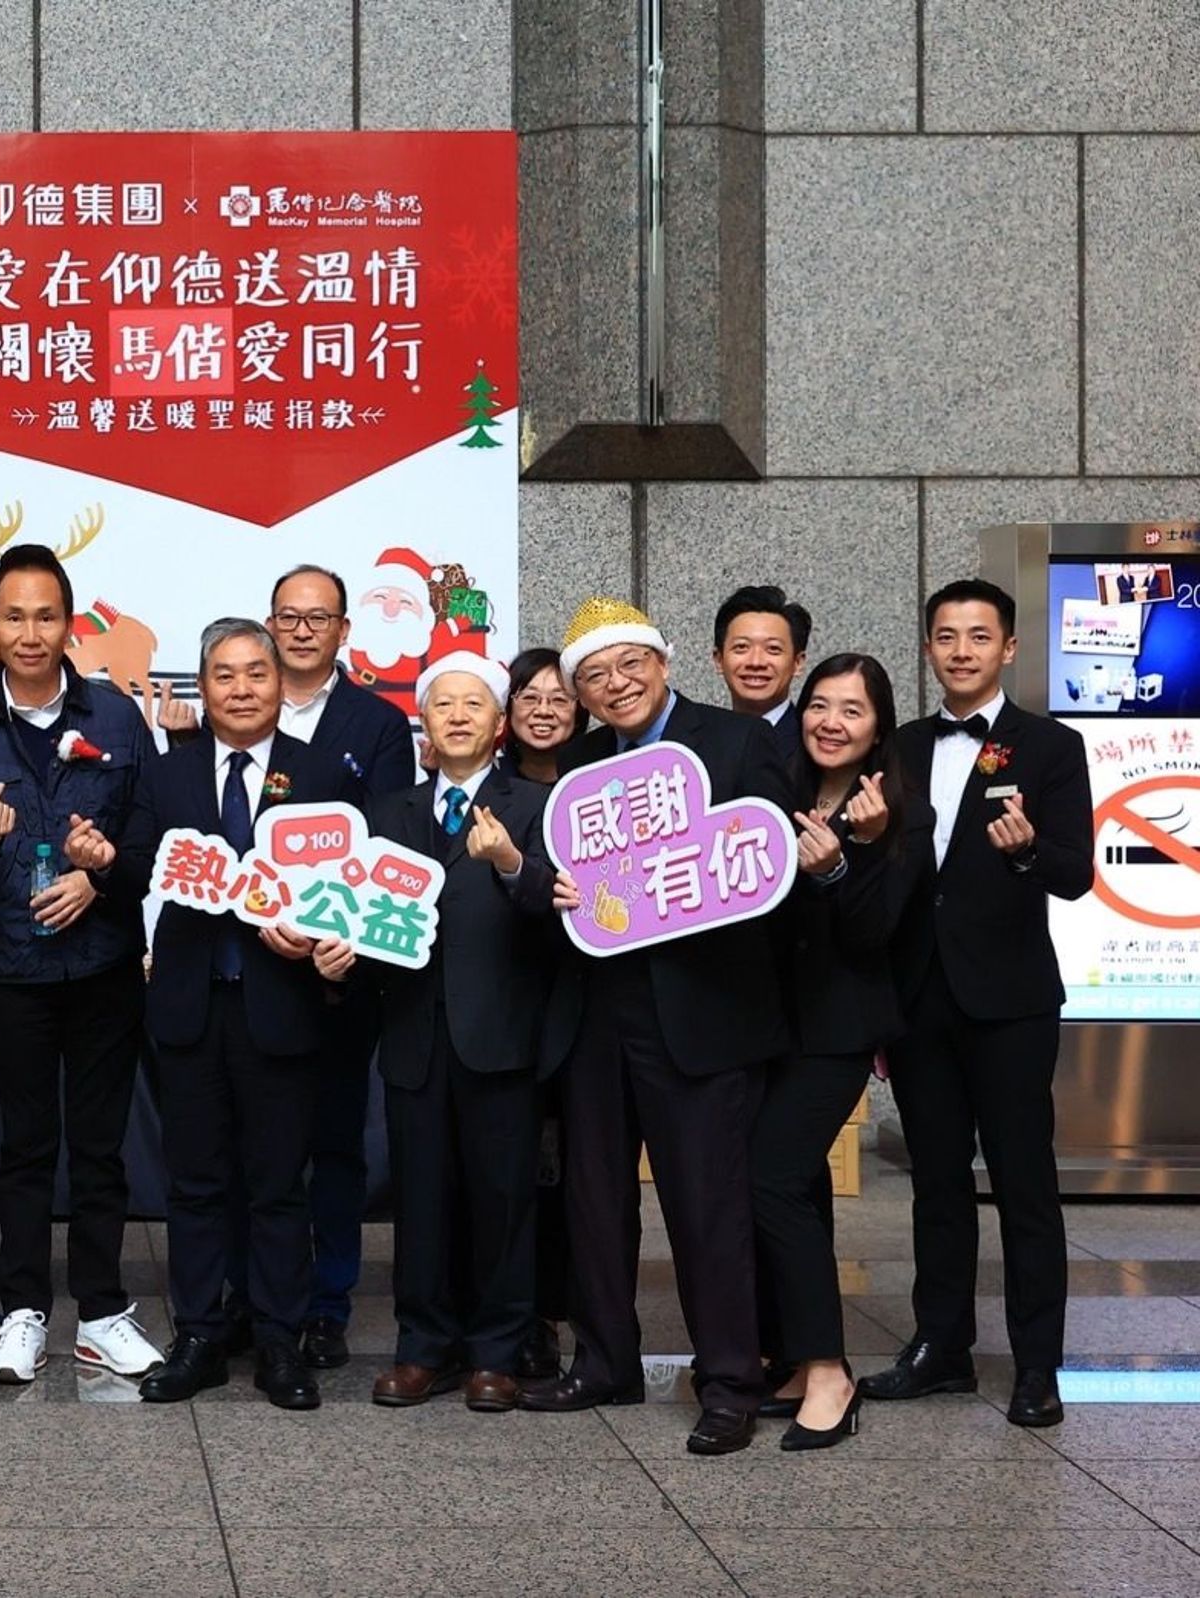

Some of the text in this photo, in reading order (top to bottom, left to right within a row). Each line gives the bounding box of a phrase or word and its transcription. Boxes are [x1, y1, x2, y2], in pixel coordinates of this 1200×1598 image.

[268, 216, 422, 228] MacKay Memorial Hospital
[46, 399, 357, 433] 溫馨送暖聖誕捐款
[568, 765, 688, 864] 感謝
[309, 830, 344, 850] 100
[398, 873, 422, 891] 100
[642, 826, 775, 921] 有你
[160, 838, 428, 959] 熱心公益
